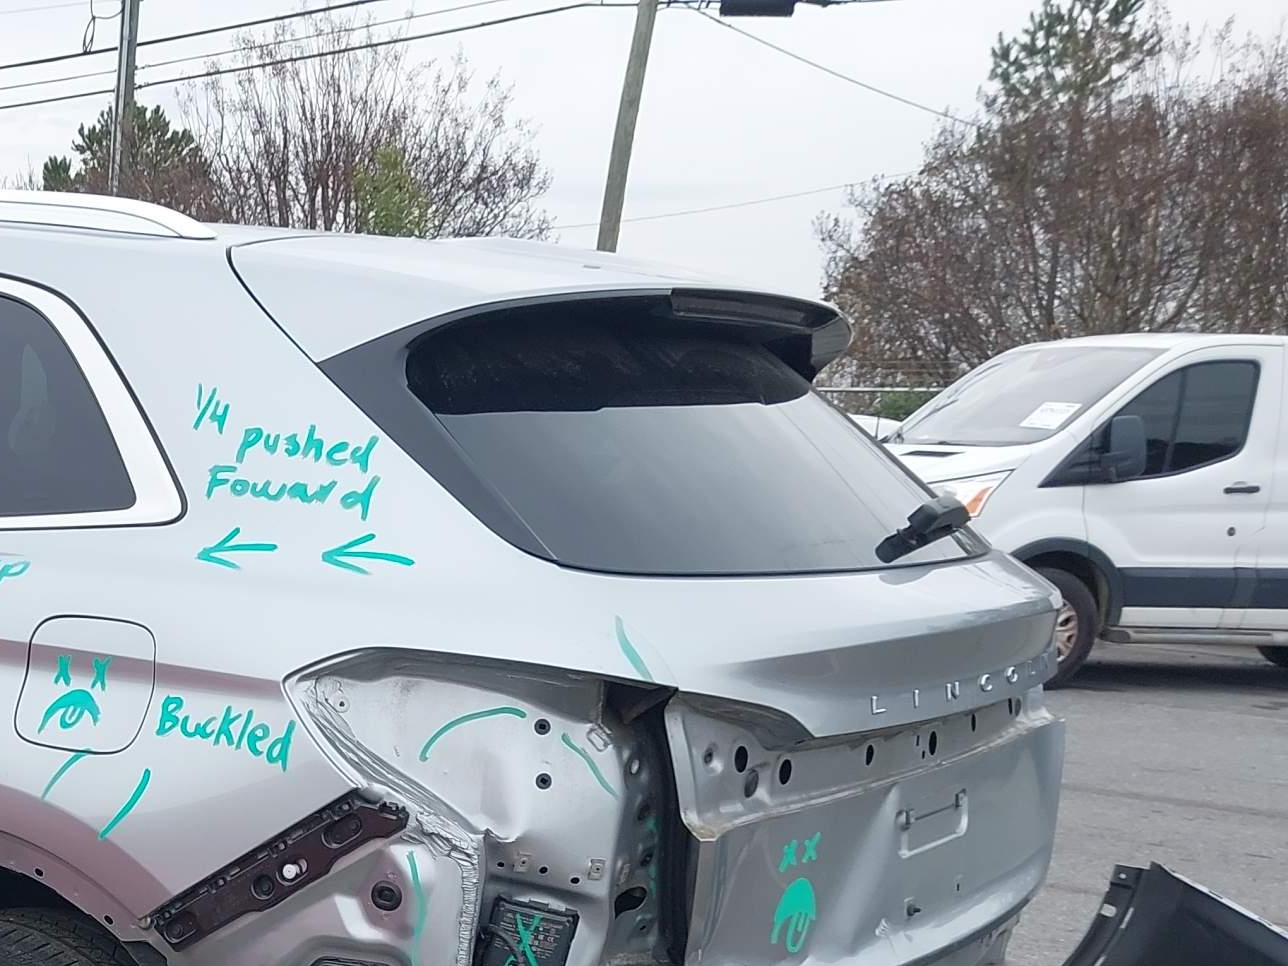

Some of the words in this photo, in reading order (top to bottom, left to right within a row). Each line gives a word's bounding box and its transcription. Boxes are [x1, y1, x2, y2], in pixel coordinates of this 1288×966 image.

[192, 383, 231, 435] 1/4
[235, 424, 380, 474] pushed
[205, 464, 382, 522] Foward
[155, 694, 297, 773] Buckled
